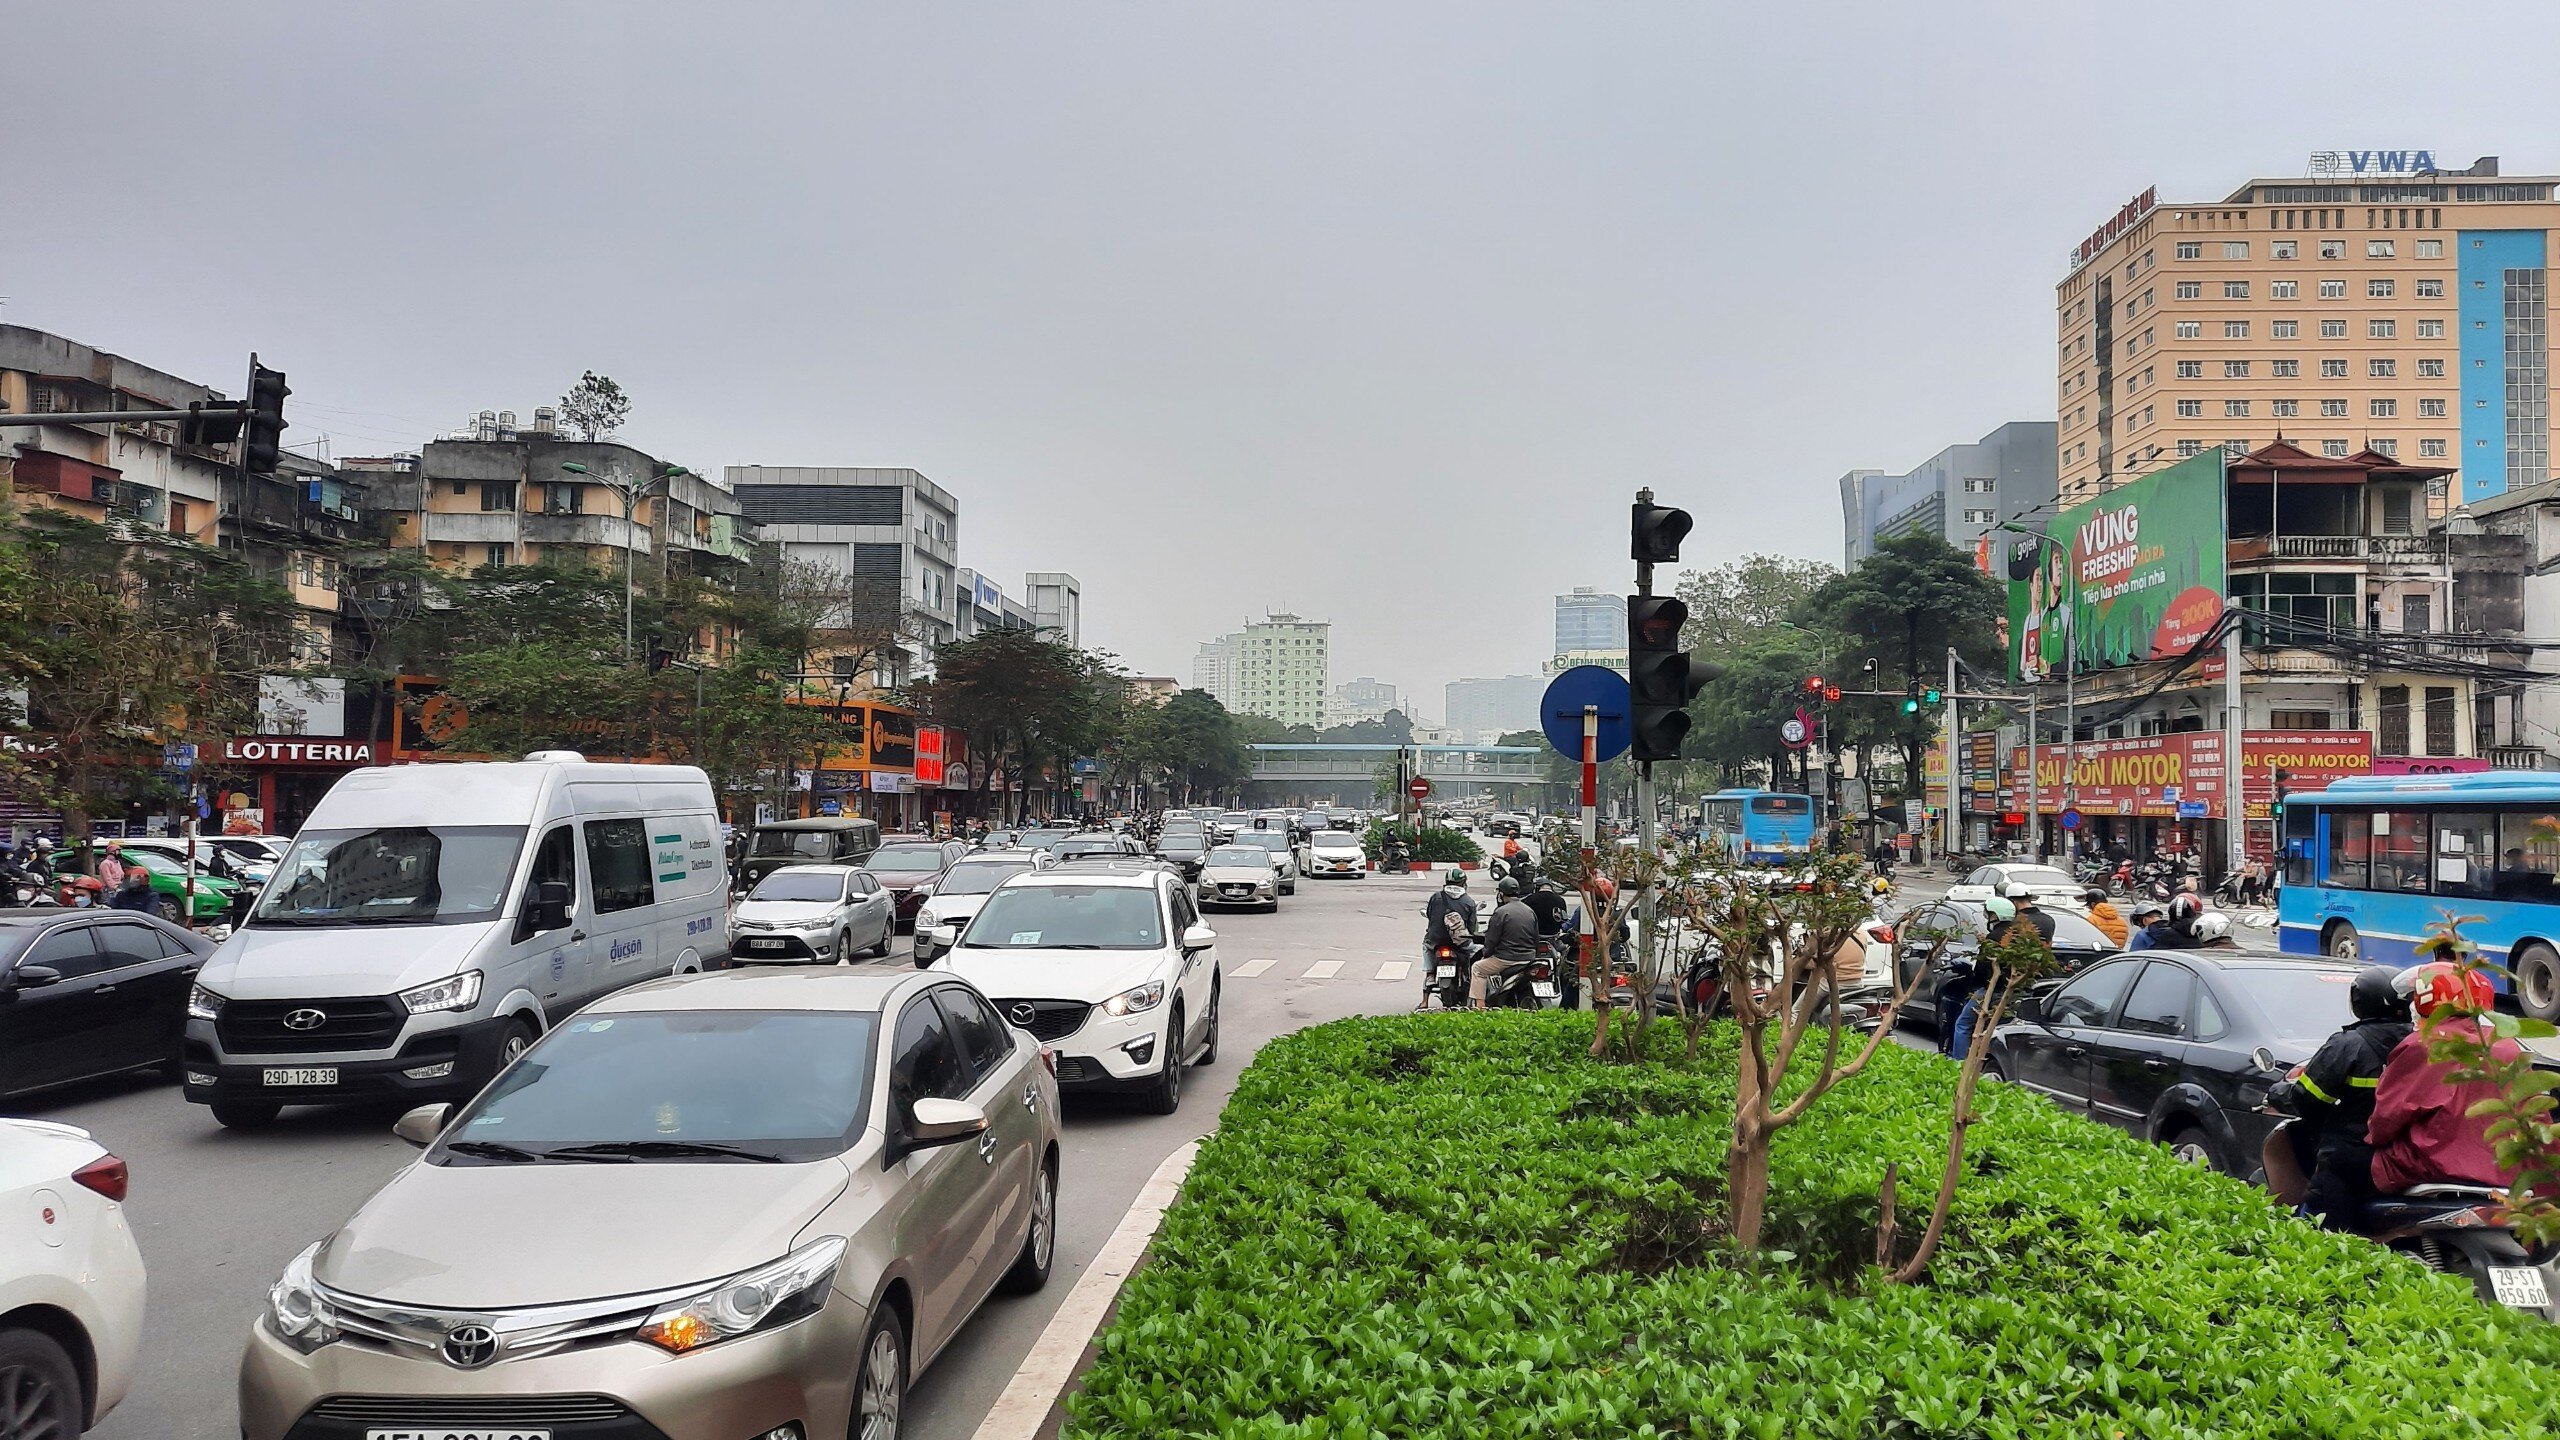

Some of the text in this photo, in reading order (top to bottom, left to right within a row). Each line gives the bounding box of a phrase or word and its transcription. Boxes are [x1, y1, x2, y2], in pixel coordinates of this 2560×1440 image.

[2347, 150, 2436, 174] VWA
[2081, 504, 2139, 556] VÙNG
[2017, 534, 2038, 561] gojek
[2082, 544, 2138, 583] FREESHIP
[2113, 580, 2129, 597] cho
[2148, 566, 2166, 587] nhà
[1826, 687, 1841, 700] 43
[226, 742, 370, 761] LOTTERIA
[2264, 751, 2304, 767] GÒN
[2309, 754, 2370, 768] MOTOR
[2037, 755, 2060, 787] SÀI
[2111, 752, 2183, 786] MOTOR
[265, 1069, 336, 1085] 29D-128.39
[2497, 1269, 2536, 1286] 29-S1
[2499, 1288, 2548, 1305] 859.60
